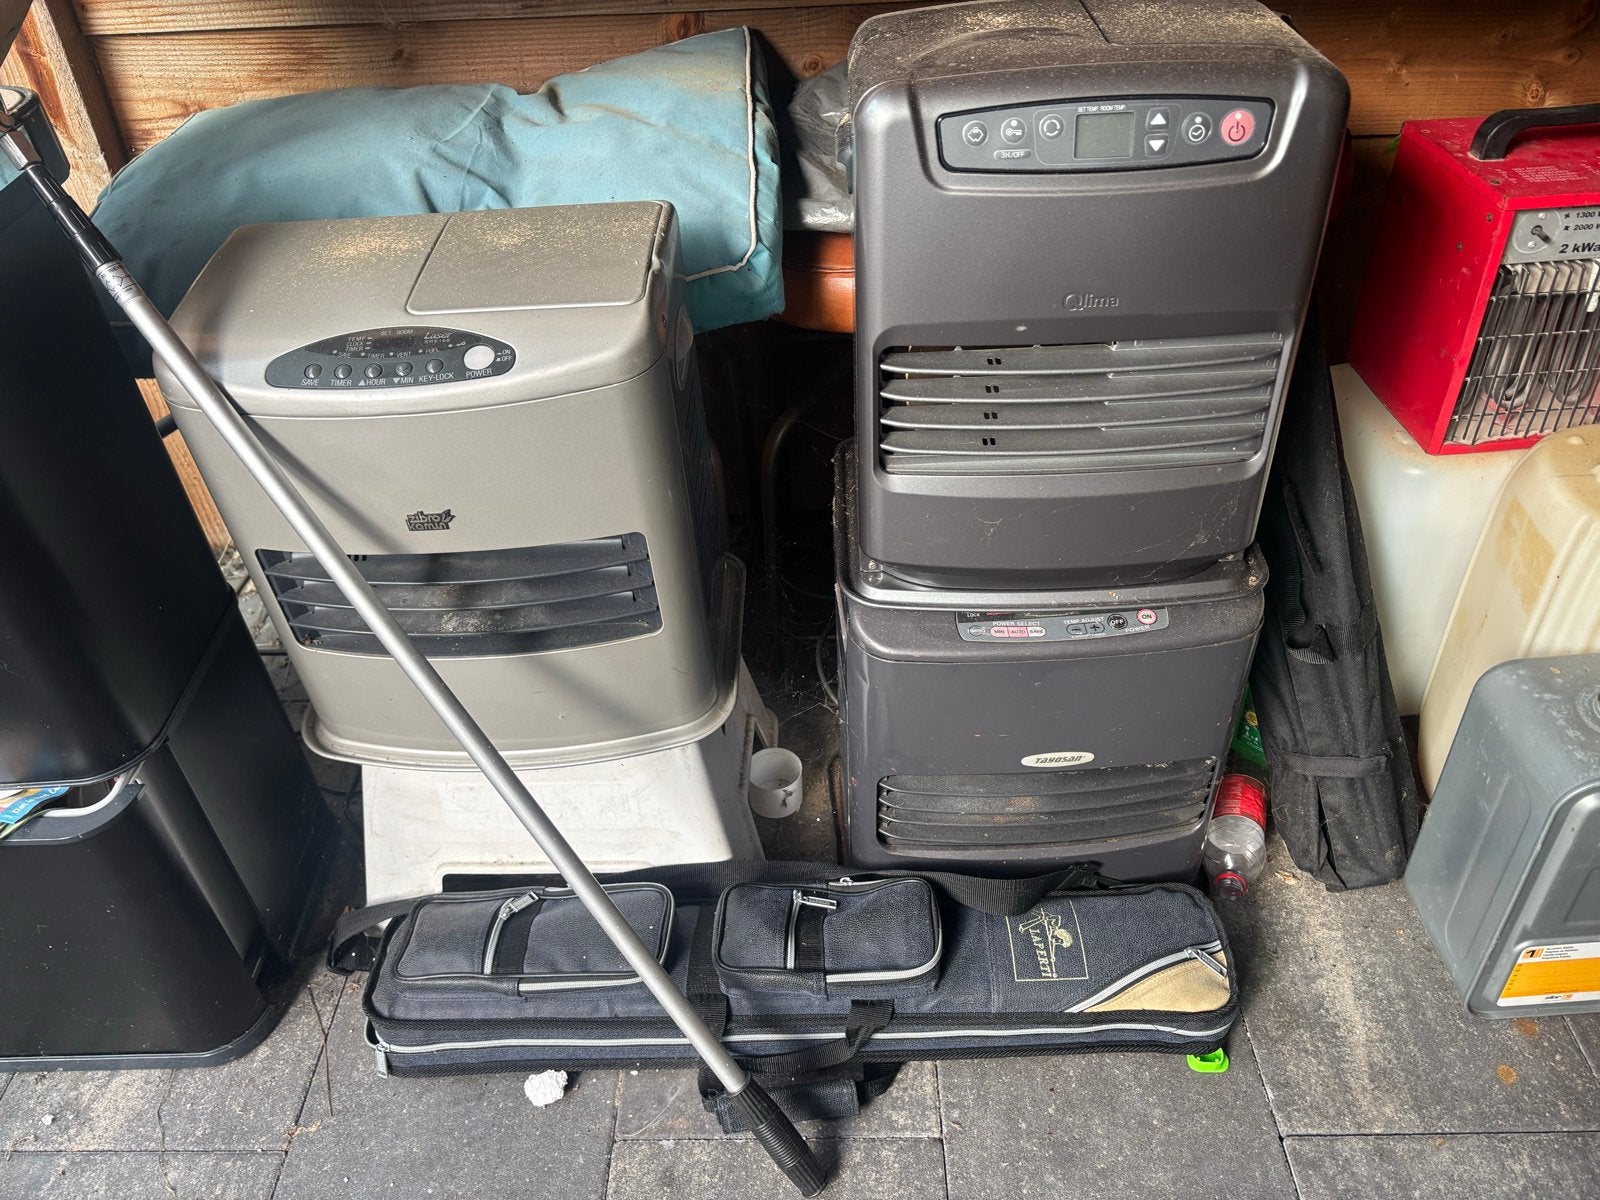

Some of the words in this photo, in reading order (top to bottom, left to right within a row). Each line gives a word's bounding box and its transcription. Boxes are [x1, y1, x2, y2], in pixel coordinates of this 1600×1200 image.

[1576, 211, 1595, 219] 1300
[1573, 223, 1594, 231] 2000
[1559, 243, 1569, 253] 2
[1063, 292, 1120, 312] Qlima
[300, 379, 319, 387] SAVE
[330, 379, 352, 387] TIMER
[366, 378, 386, 386] HOUR
[418, 372, 455, 383] KEY-LOCK
[465, 368, 493, 378] POWER
[407, 511, 441, 523] zibro
[1125, 624, 1151, 633] POWER
